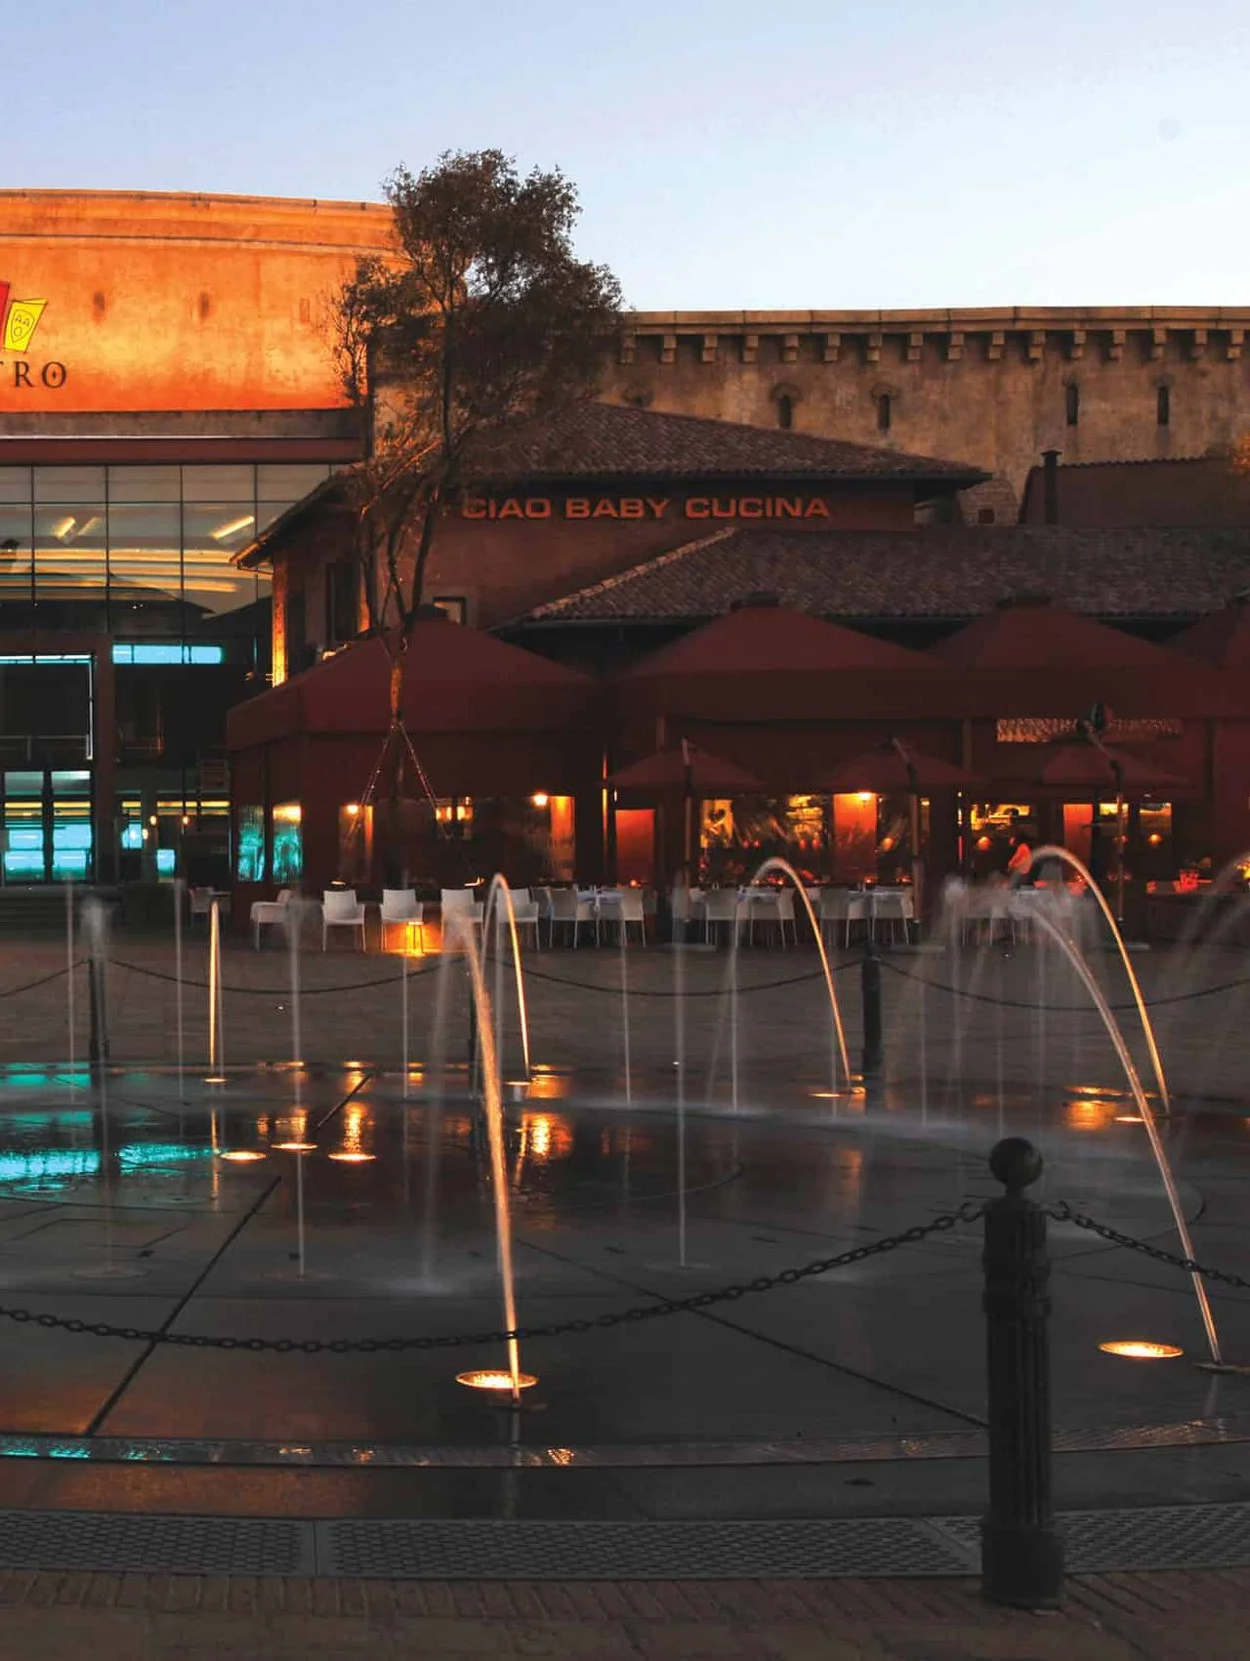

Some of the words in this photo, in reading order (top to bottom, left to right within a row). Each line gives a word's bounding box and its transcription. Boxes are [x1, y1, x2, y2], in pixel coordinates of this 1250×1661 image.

[462, 497, 551, 519] CIAO
[565, 497, 670, 519] BABY
[685, 497, 830, 519] CUCINA
